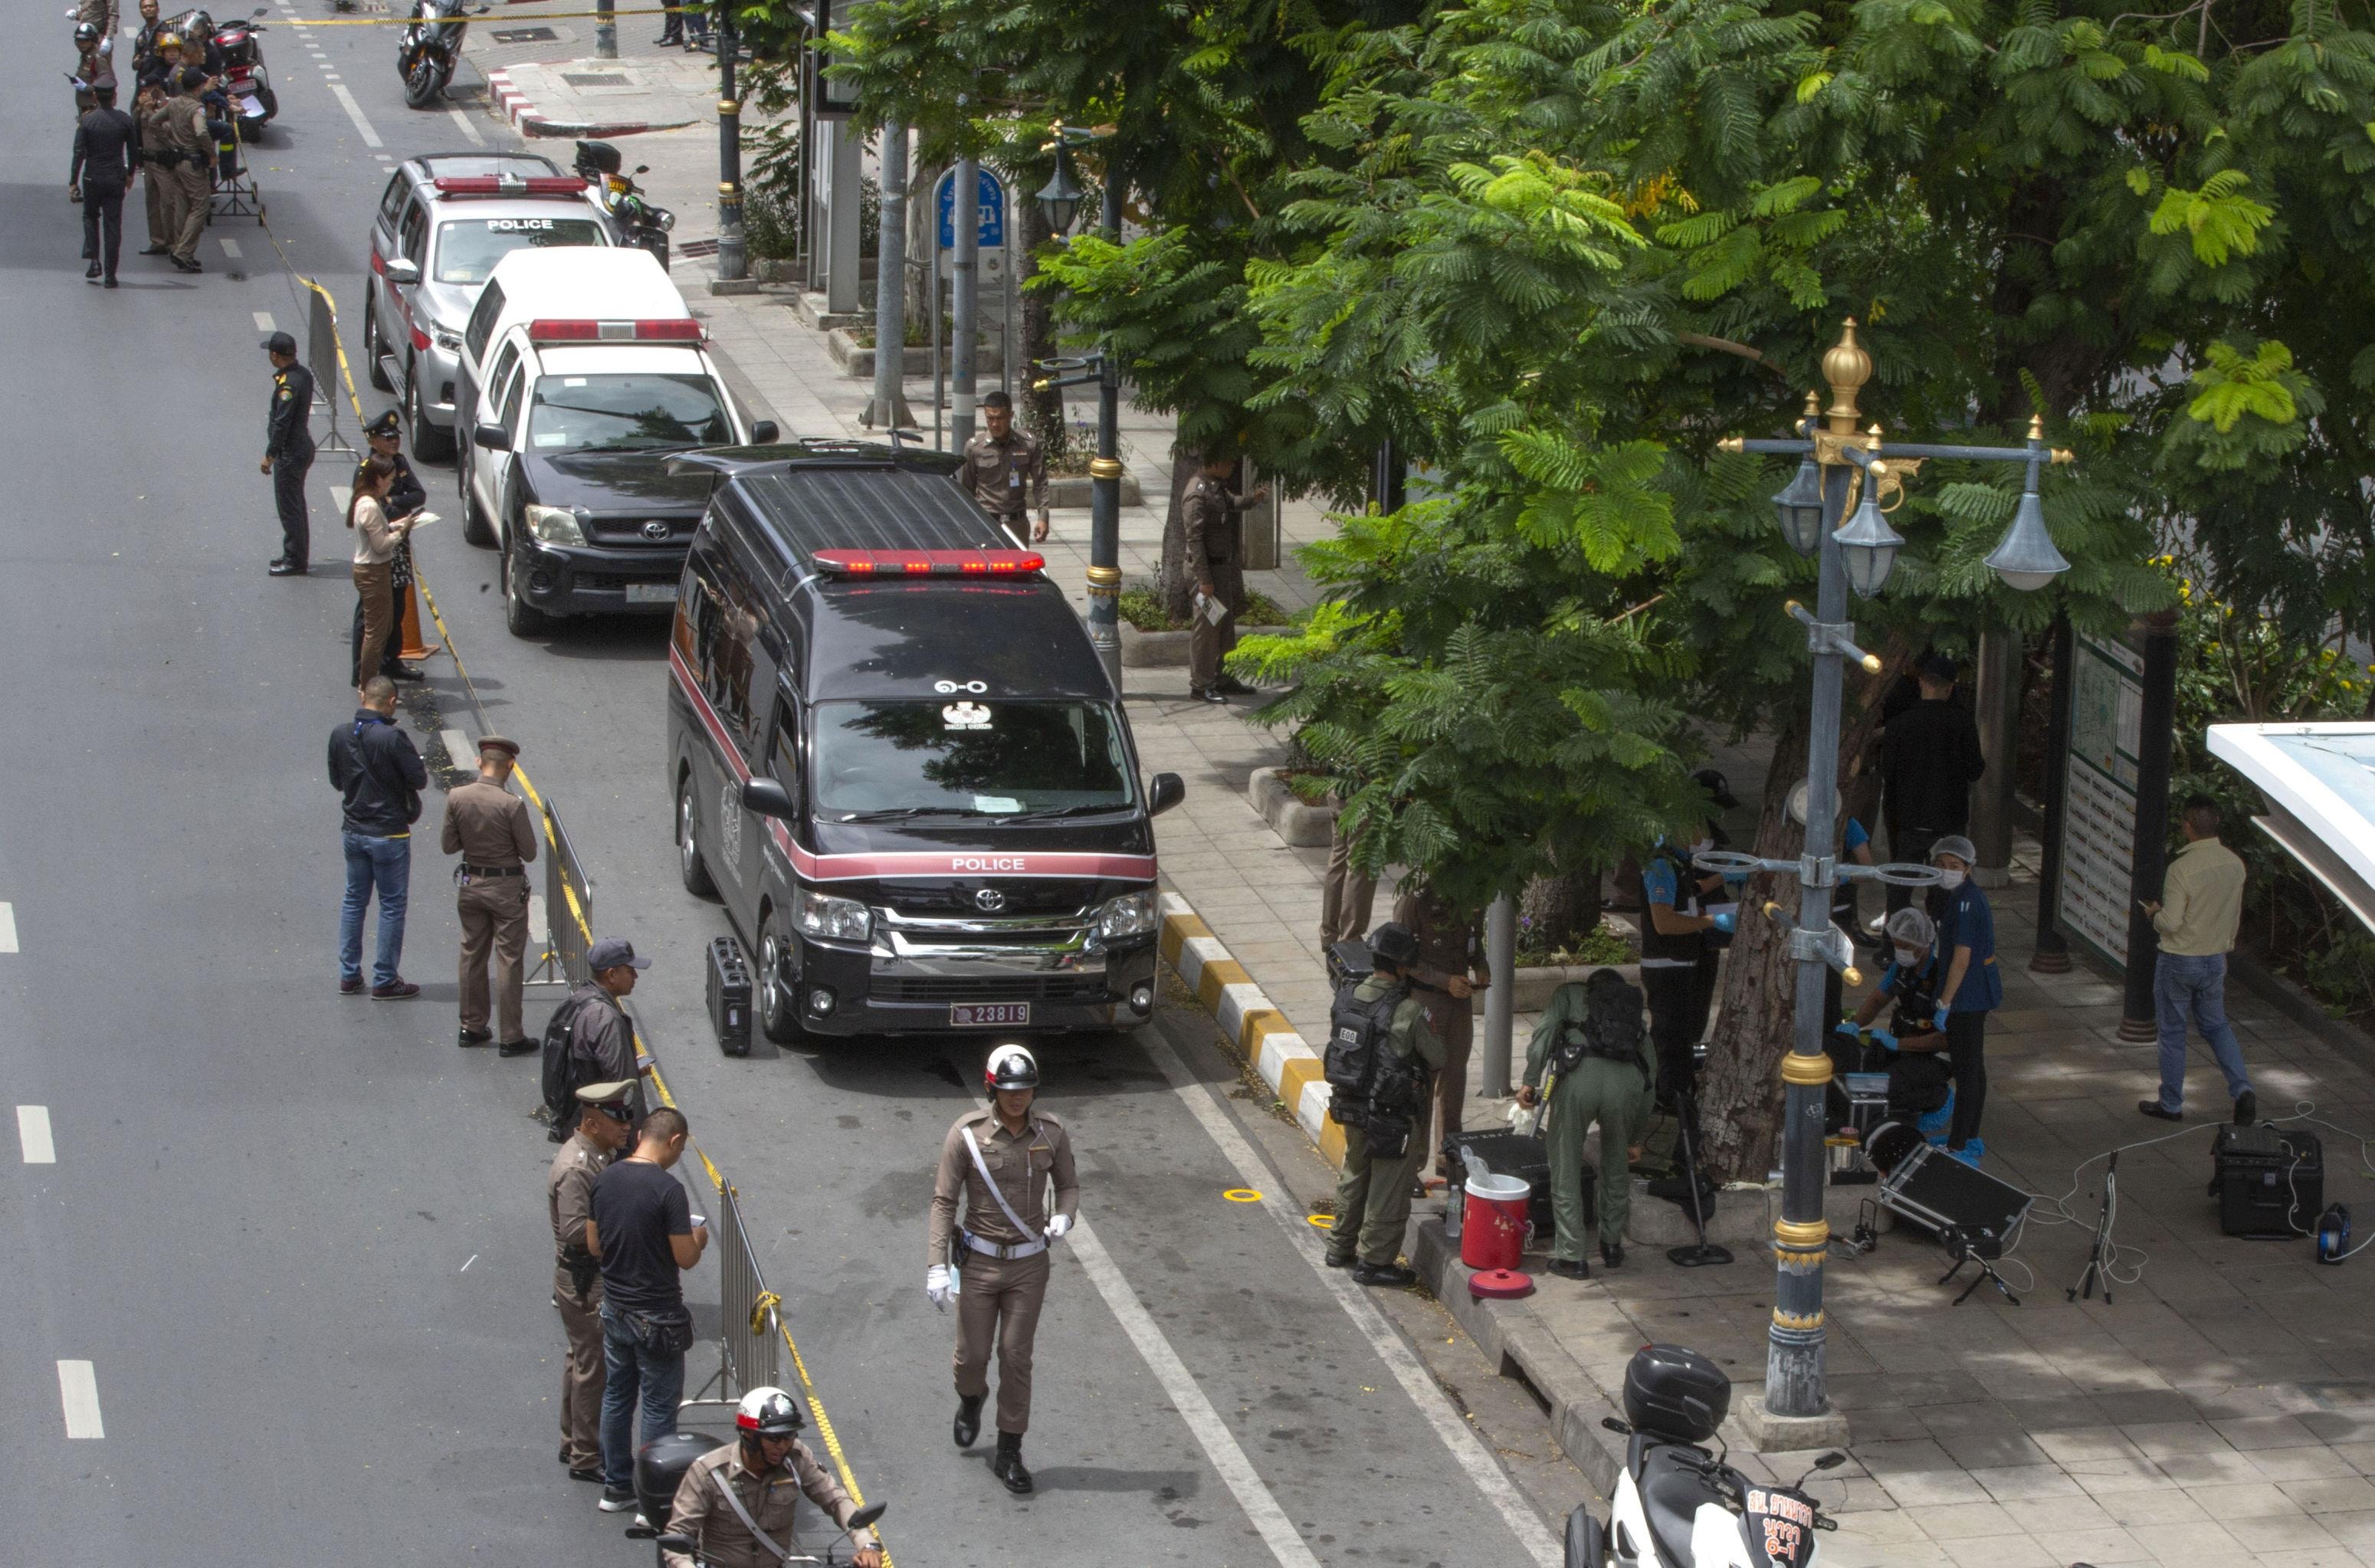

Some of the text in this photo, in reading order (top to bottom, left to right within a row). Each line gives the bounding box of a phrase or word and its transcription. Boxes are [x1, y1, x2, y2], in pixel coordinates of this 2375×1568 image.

[487, 220, 553, 230] POLICE
[952, 858, 1025, 871] POLICE
[976, 1005, 1026, 1022] 23819
[1341, 1029, 1355, 1042] EOD
[1763, 1517, 1801, 1546] นาวา
[1765, 1536, 1796, 1561] 6-1
